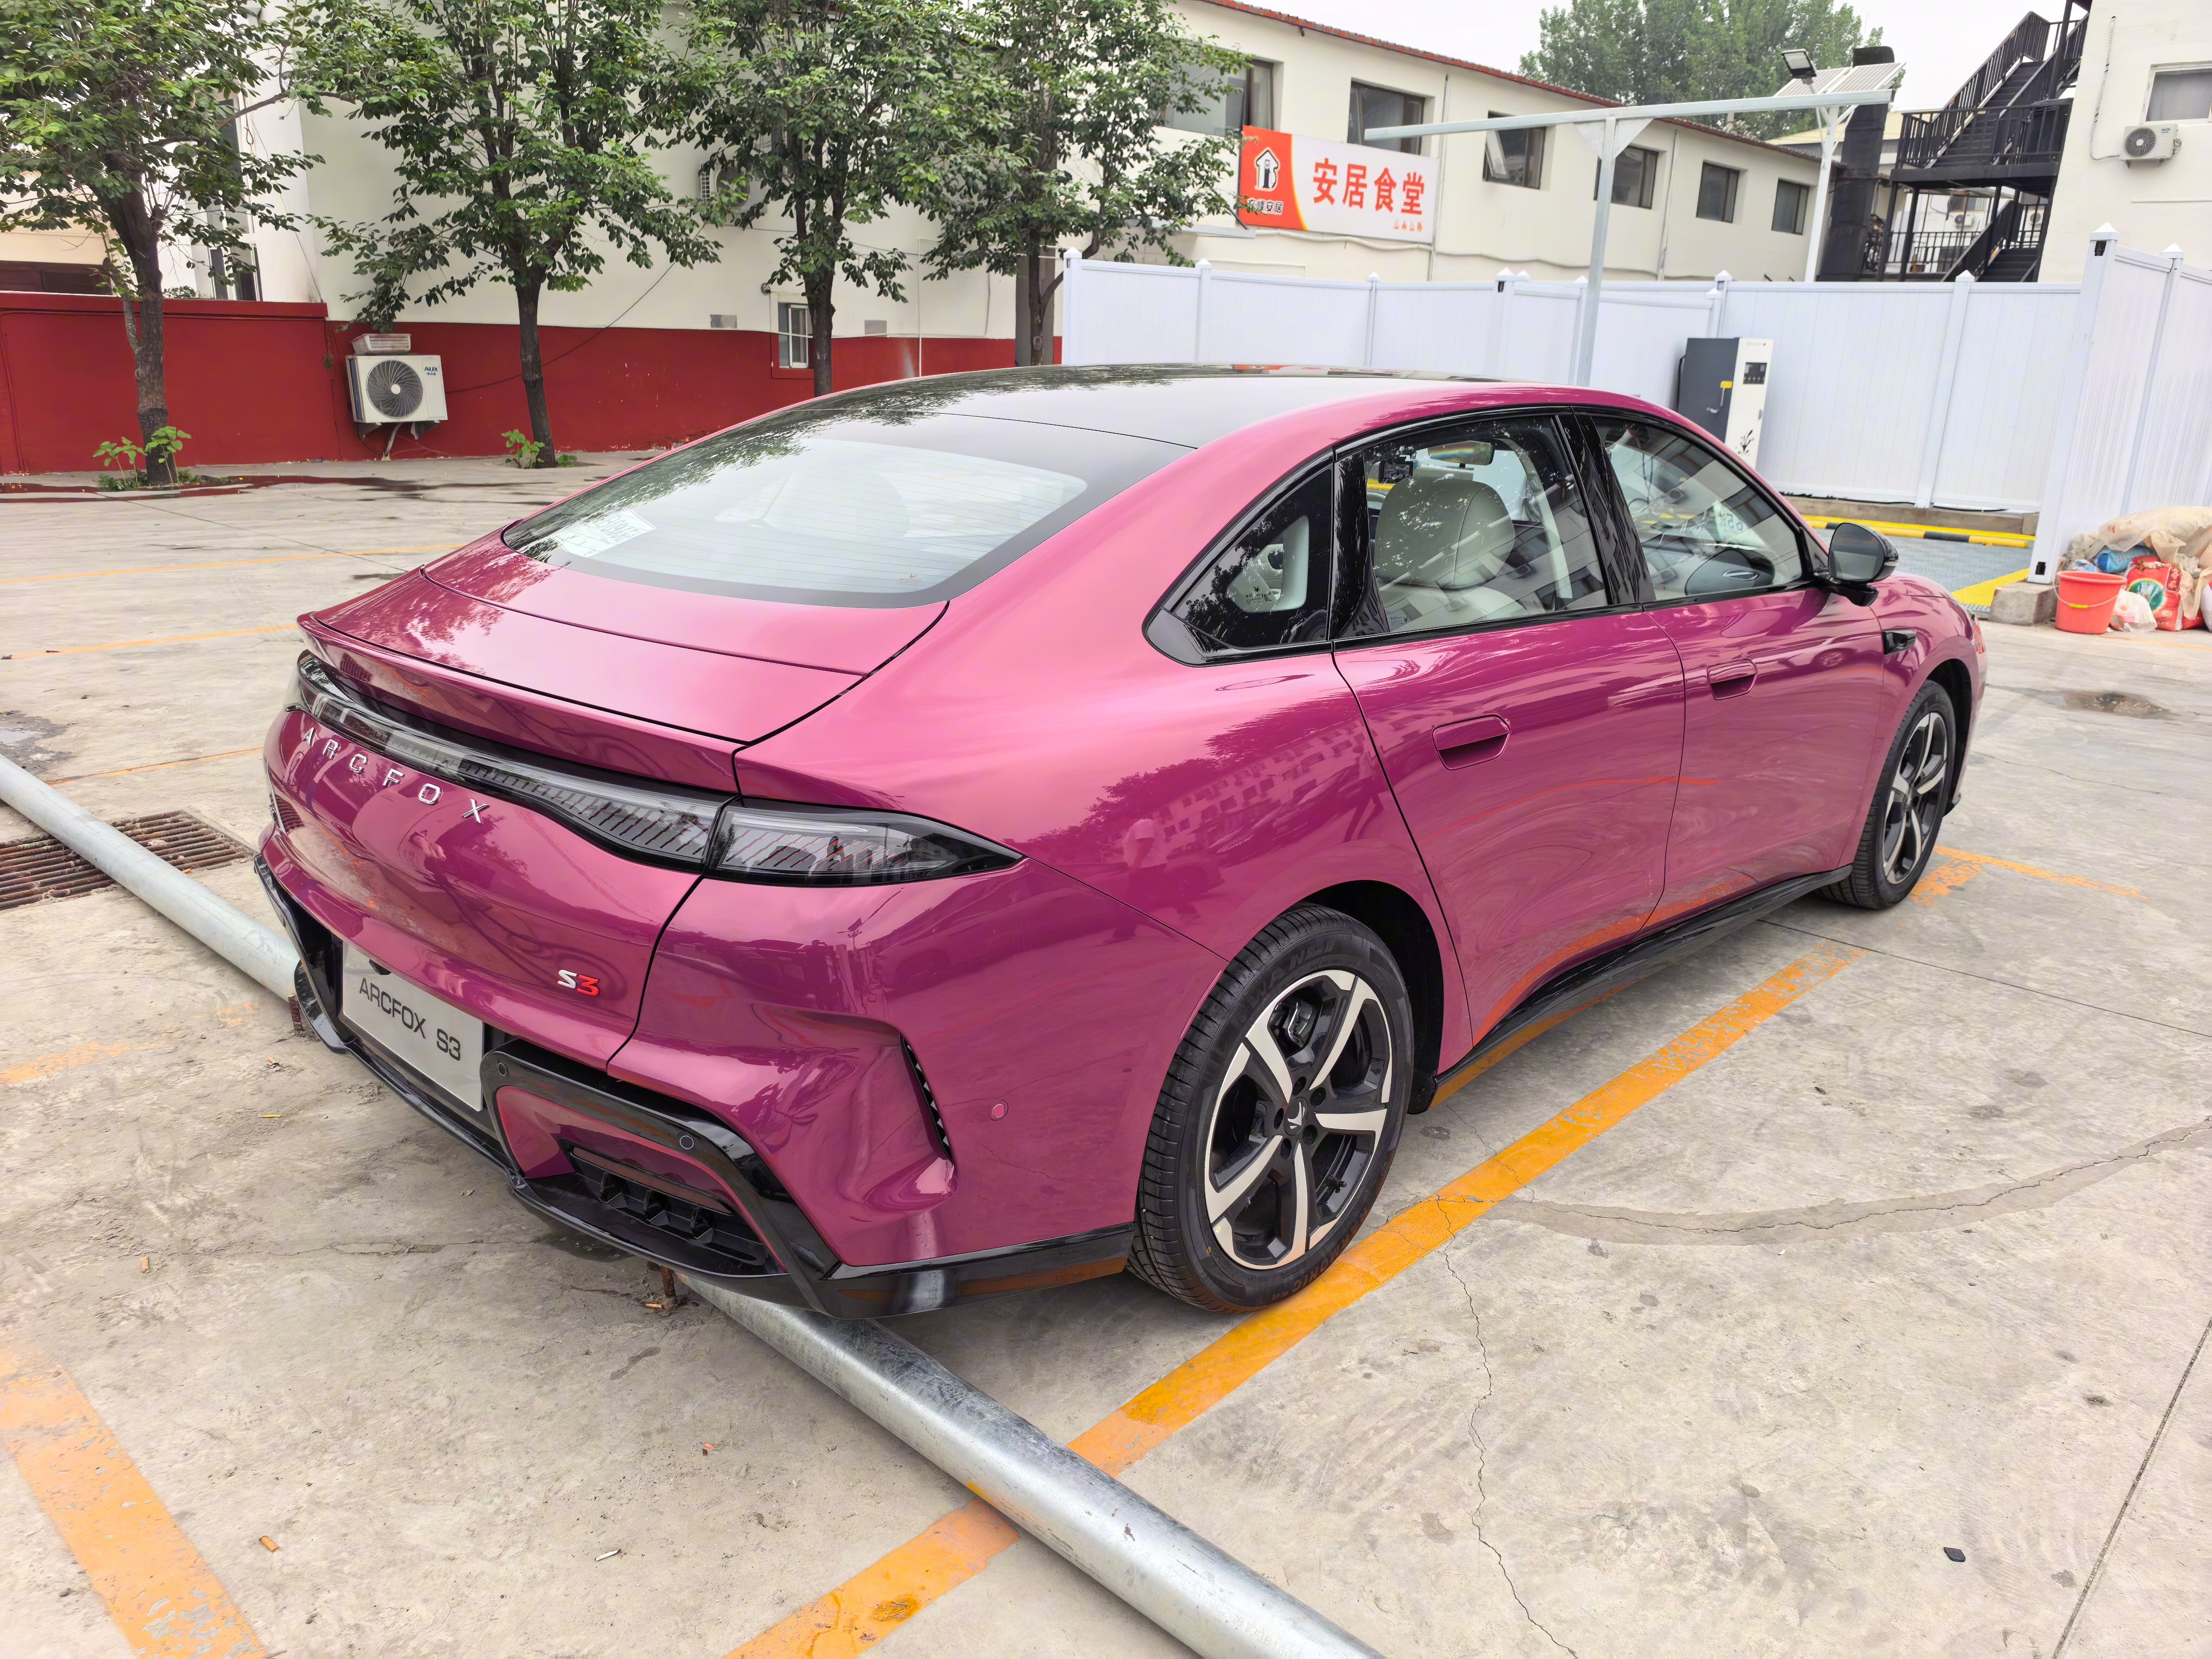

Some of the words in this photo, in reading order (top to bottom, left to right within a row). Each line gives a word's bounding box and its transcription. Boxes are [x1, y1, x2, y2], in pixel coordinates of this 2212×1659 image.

[1313, 158, 1424, 215] 安居食堂
[301, 726, 491, 824] ARCFOX
[557, 969, 600, 996] S3
[359, 977, 426, 1040] ARCFOX
[436, 1028, 462, 1062] S3
